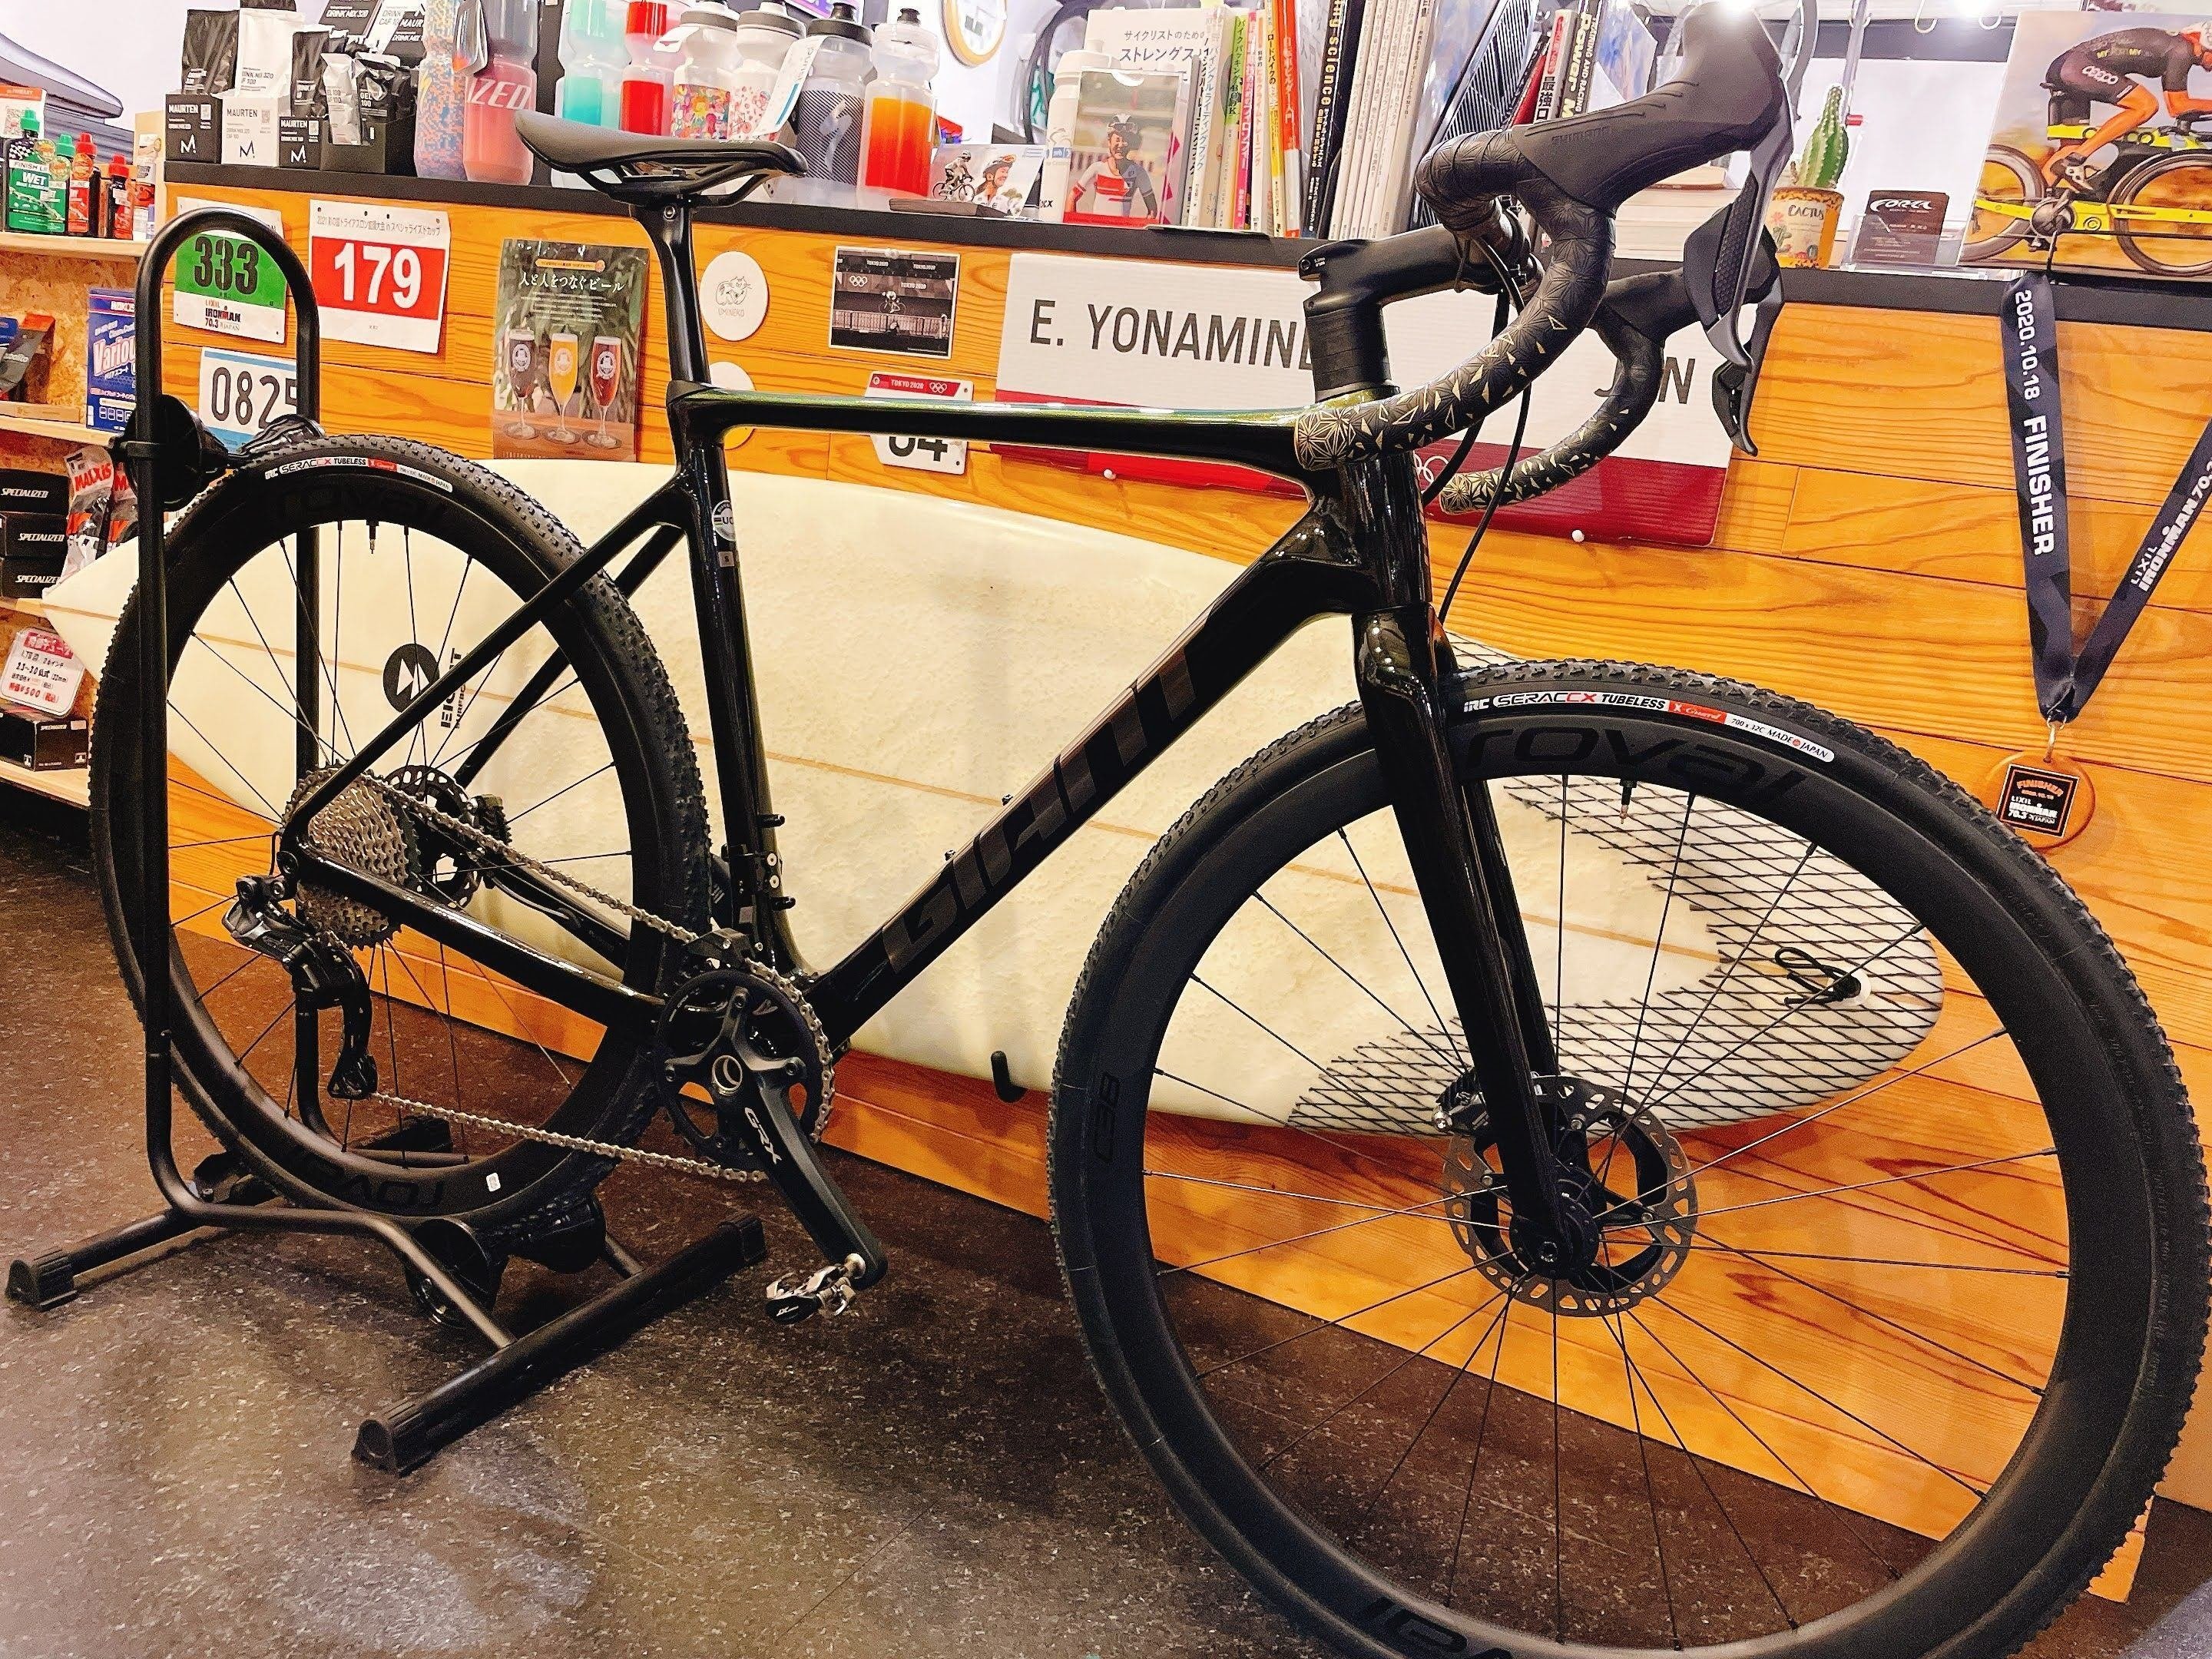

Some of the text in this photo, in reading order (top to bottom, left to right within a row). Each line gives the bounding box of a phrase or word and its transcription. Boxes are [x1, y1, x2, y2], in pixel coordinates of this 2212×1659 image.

[399, 19, 424, 28] MAUR
[1120, 47, 1201, 62] ストレングス
[1568, 13, 1592, 92] Power
[1575, 18, 1597, 112] TRAINING AND RACING
[168, 104, 198, 114] MAURTEN
[227, 109, 257, 118] MAURTEN
[280, 120, 307, 128] MAURTEN
[23, 171, 47, 185] WET
[1788, 204, 1824, 220] CACTUS
[194, 237, 259, 295] 333
[334, 242, 421, 309] 179
[519, 272, 624, 293] 人と人をつなぐビール
[205, 306, 240, 323] IRONMAN
[205, 318, 219, 329] 70.3
[1031, 300, 1064, 347] E.
[93, 335, 136, 376] Variou
[2015, 290, 2041, 400] 2020.10.18
[891, 379, 924, 390] TOKYO 2020
[74, 462, 112, 492] MAXXIS
[2024, 415, 2055, 555] FINISHER
[1, 488, 48, 498] SPECIALIZED
[18, 533, 65, 542] SPECIALIZED
[2138, 498, 2198, 592] IRONMAN
[2131, 546, 2157, 584] LIXIL
[1601, 694, 1666, 710] TUBELESS
[1731, 718, 1744, 727] 700
[1767, 729, 1793, 743] MADE
[1800, 742, 1829, 759] JAPAN
[882, 647, 1197, 974] GIANT
[2011, 796, 2032, 805] LIXIL
[2008, 810, 2028, 820] 70.3
[744, 1107, 783, 1164] GRX
